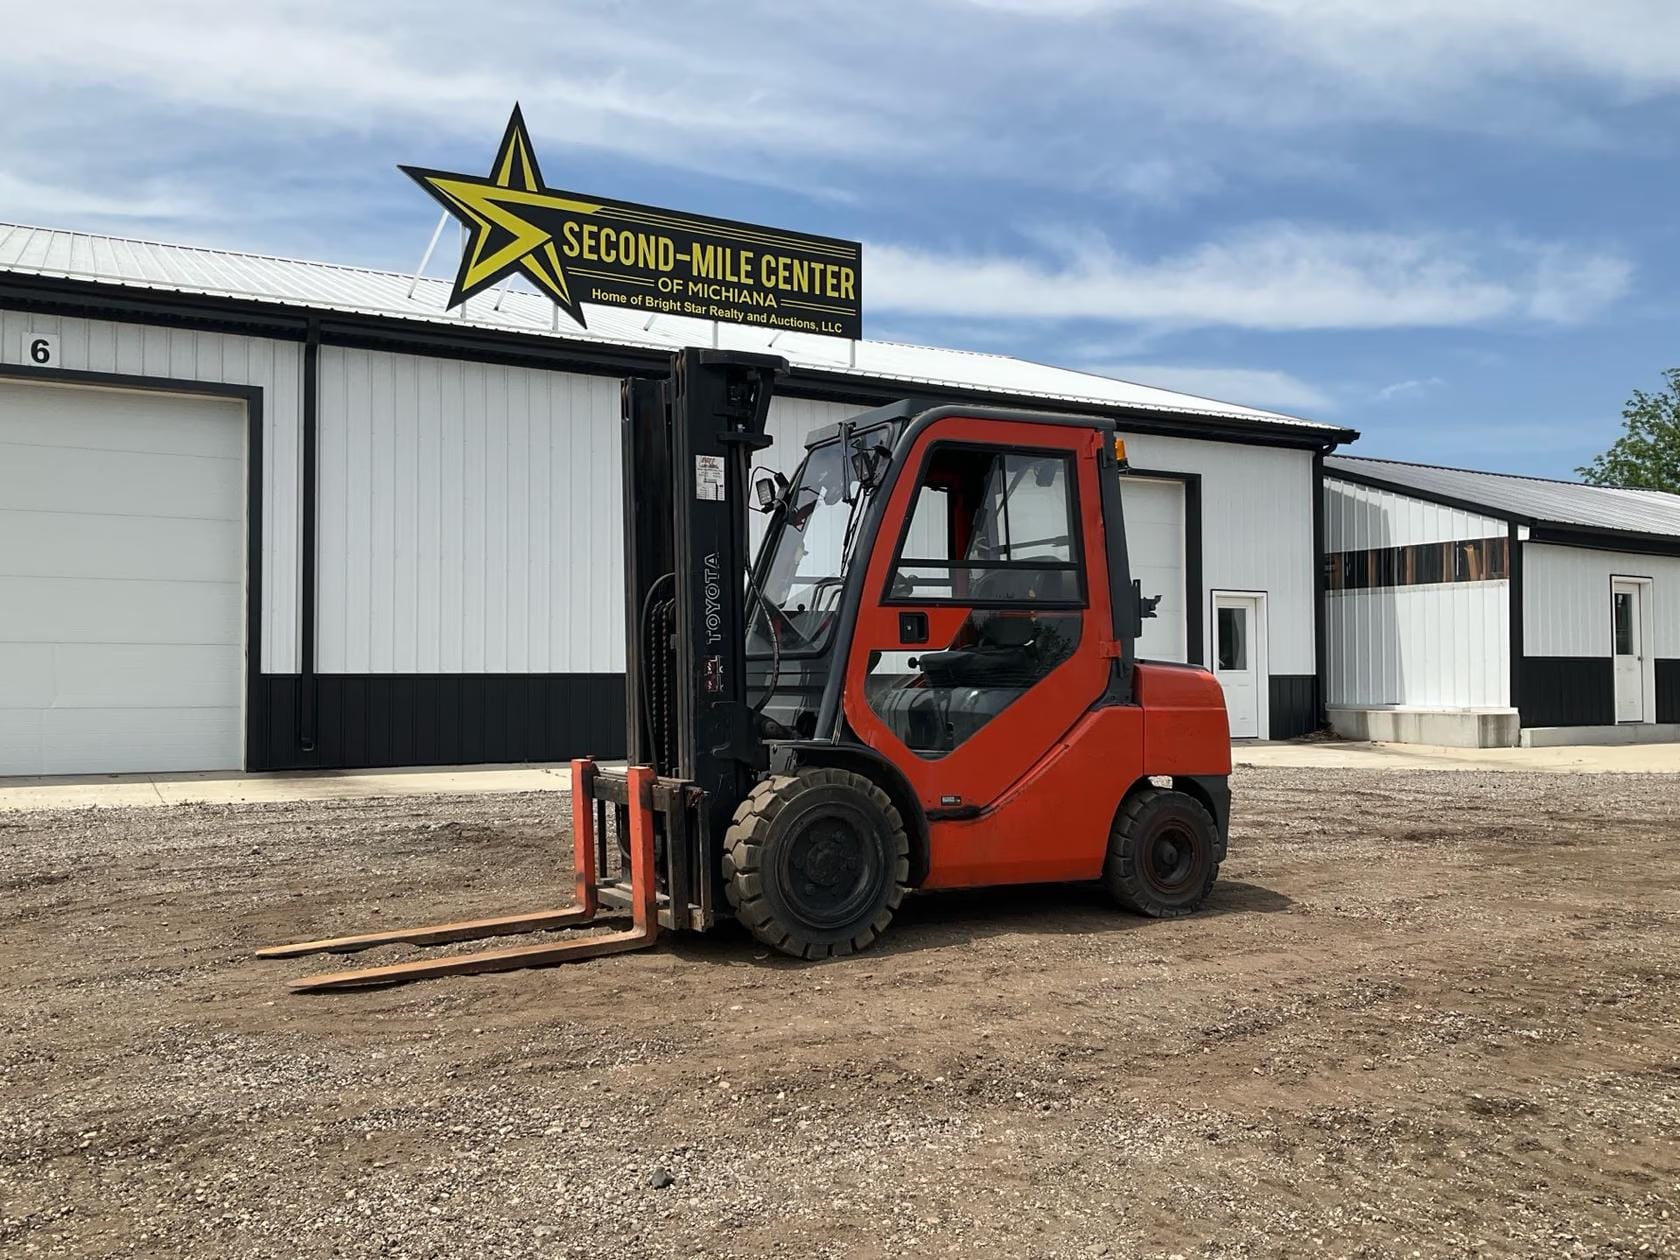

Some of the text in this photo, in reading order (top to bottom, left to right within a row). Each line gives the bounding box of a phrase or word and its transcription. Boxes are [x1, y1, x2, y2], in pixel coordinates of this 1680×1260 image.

[562, 220, 855, 300] SECOND-MILE CENTER
[592, 288, 843, 333] Home of Bright Star Realty and Auctions, LLC
[658, 277, 777, 308] OF MICHIANA
[31, 339, 50, 363] 6
[704, 551, 721, 645] TOYOTA
